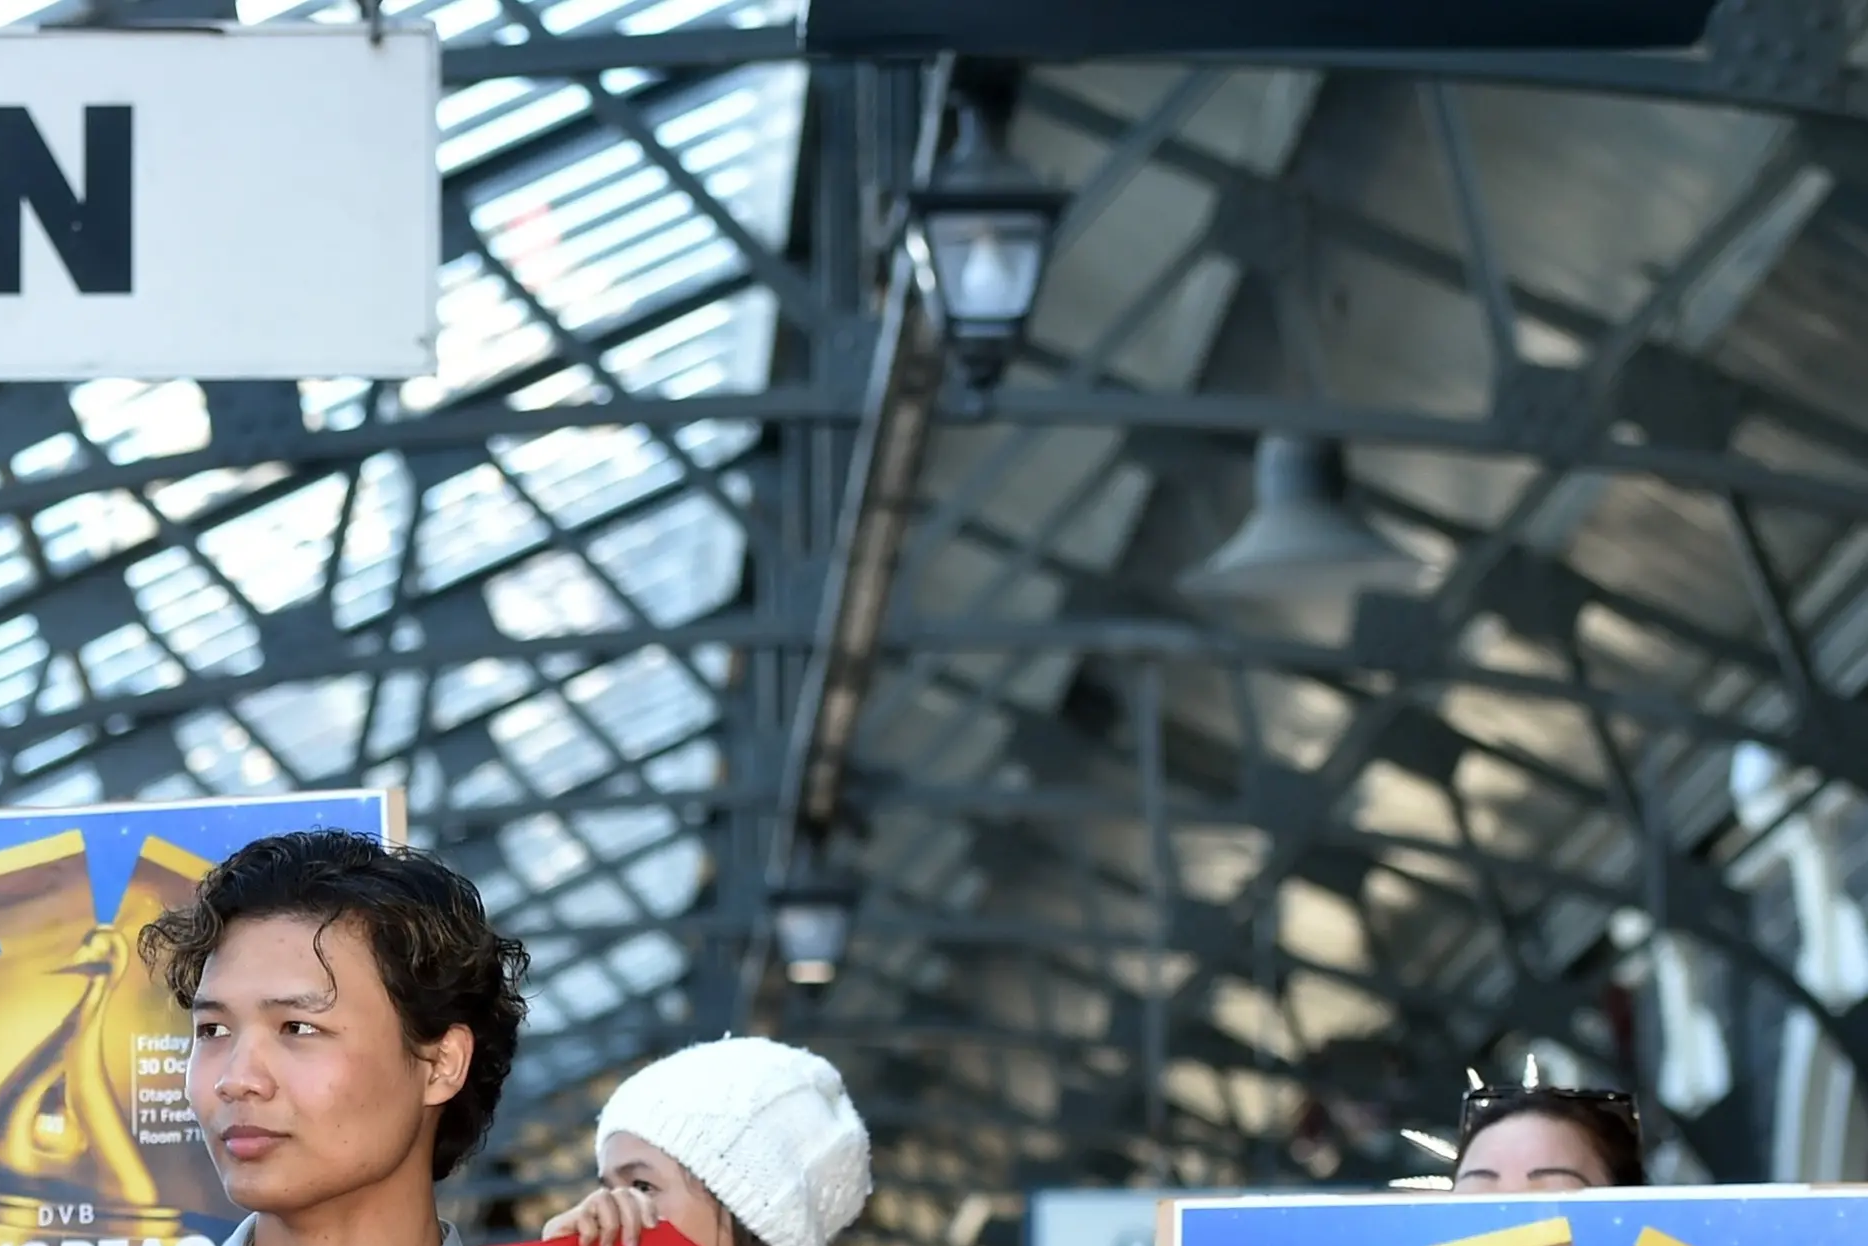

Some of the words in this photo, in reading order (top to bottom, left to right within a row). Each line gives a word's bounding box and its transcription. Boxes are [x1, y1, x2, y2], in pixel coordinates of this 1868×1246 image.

[138, 1036, 190, 1055] Friday
[139, 1058, 160, 1074] 30
[139, 1088, 182, 1104] Otago
[140, 1109, 157, 1123] 71
[140, 1129, 181, 1144] Room
